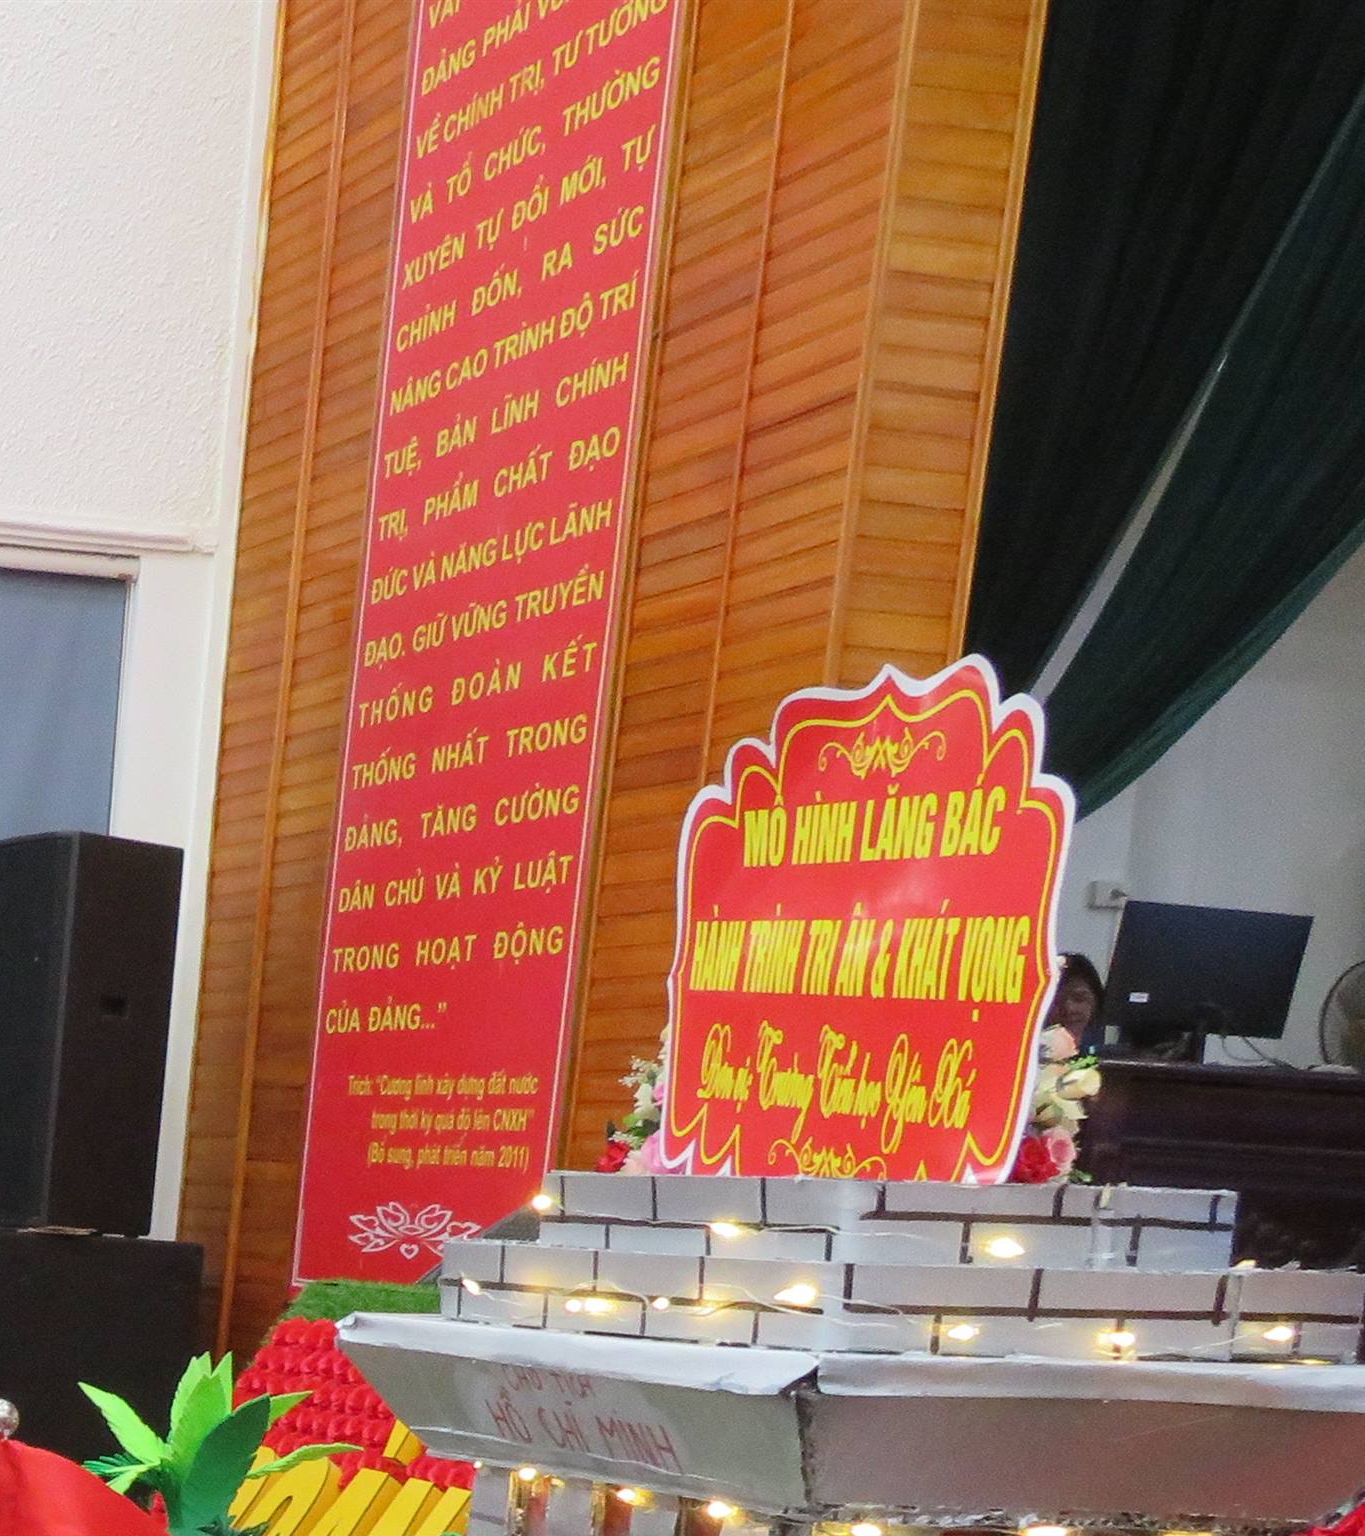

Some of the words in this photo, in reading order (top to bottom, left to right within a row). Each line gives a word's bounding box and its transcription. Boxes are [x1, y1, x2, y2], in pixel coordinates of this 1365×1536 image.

[416, 112, 440, 159] VỀ
[442, 83, 504, 141] CHÍNH
[508, 59, 545, 101] TRỊ,
[552, 28, 586, 75] TƯ
[421, 38, 477, 95] ĐẢNG
[482, 0, 534, 55] PHẢI
[409, 182, 434, 223] VÀ
[446, 151, 473, 202] TỔ
[563, 55, 660, 135] THƯỜNG
[402, 233, 466, 288] XUYÊN
[476, 207, 504, 249] TỰ
[510, 175, 550, 230] ĐỔI
[559, 155, 606, 203] MỚI,
[621, 124, 655, 171] TỰ
[395, 299, 457, 352] CHỈNH
[471, 268, 522, 314] ĐỐN,
[540, 241, 574, 280] RA
[592, 205, 645, 254] SỨC
[389, 369, 442, 414] NÂNG
[444, 346, 489, 389] CAO
[493, 315, 557, 367] TRÌNH
[558, 291, 594, 338] ĐỘ
[599, 269, 637, 319] TRÍ
[384, 436, 421, 477] TUỆ,
[435, 415, 477, 457] BẢN
[490, 389, 540, 433] LĨNH
[554, 352, 629, 407] CHÍNH
[422, 472, 479, 524] PHẨM
[493, 444, 553, 497] CHẤT
[567, 425, 621, 470] ĐẠO
[371, 567, 408, 604] ĐỨC
[412, 552, 438, 589] VÀ
[438, 537, 499, 580] NĂNG
[500, 520, 546, 562] LỰC
[549, 498, 612, 544] LÃNH
[363, 631, 405, 666] ĐẠO.
[411, 612, 448, 652] GIỮ
[451, 599, 508, 640] VỮNG
[514, 564, 604, 621] TRUYỀN
[358, 684, 434, 727] THỐNG
[450, 658, 522, 705] ĐOÀN
[541, 635, 597, 681] KẾT
[352, 747, 417, 789] THỐNG
[430, 727, 490, 772] NHẤT
[506, 713, 588, 757] TRONG
[344, 817, 402, 851] ĐẢNG,
[420, 802, 478, 838] TĂNG
[493, 783, 580, 826] CƯỜNG
[743, 795, 787, 868] MÔ
[791, 790, 858, 866] HÌNH
[860, 785, 938, 863] LĂNG
[940, 773, 1007, 858] BÁC
[337, 879, 377, 912] DÂN
[383, 868, 425, 906] CHỦ
[435, 863, 462, 899] VÀ
[472, 856, 504, 894] KỶ
[513, 850, 573, 892] LUẬT
[332, 940, 401, 972] TRONG
[415, 932, 477, 966] HOẠT
[492, 921, 564, 964] ĐỘNG
[689, 904, 746, 992] HÀNH
[742, 903, 805, 994] TRÌNH
[801, 918, 842, 996] TRI
[834, 902, 877, 998] ÂN
[870, 921, 896, 1000] &
[892, 899, 961, 1000] KHÁT
[958, 915, 1033, 1022] VỌNG
[325, 1000, 361, 1034] CỦA
